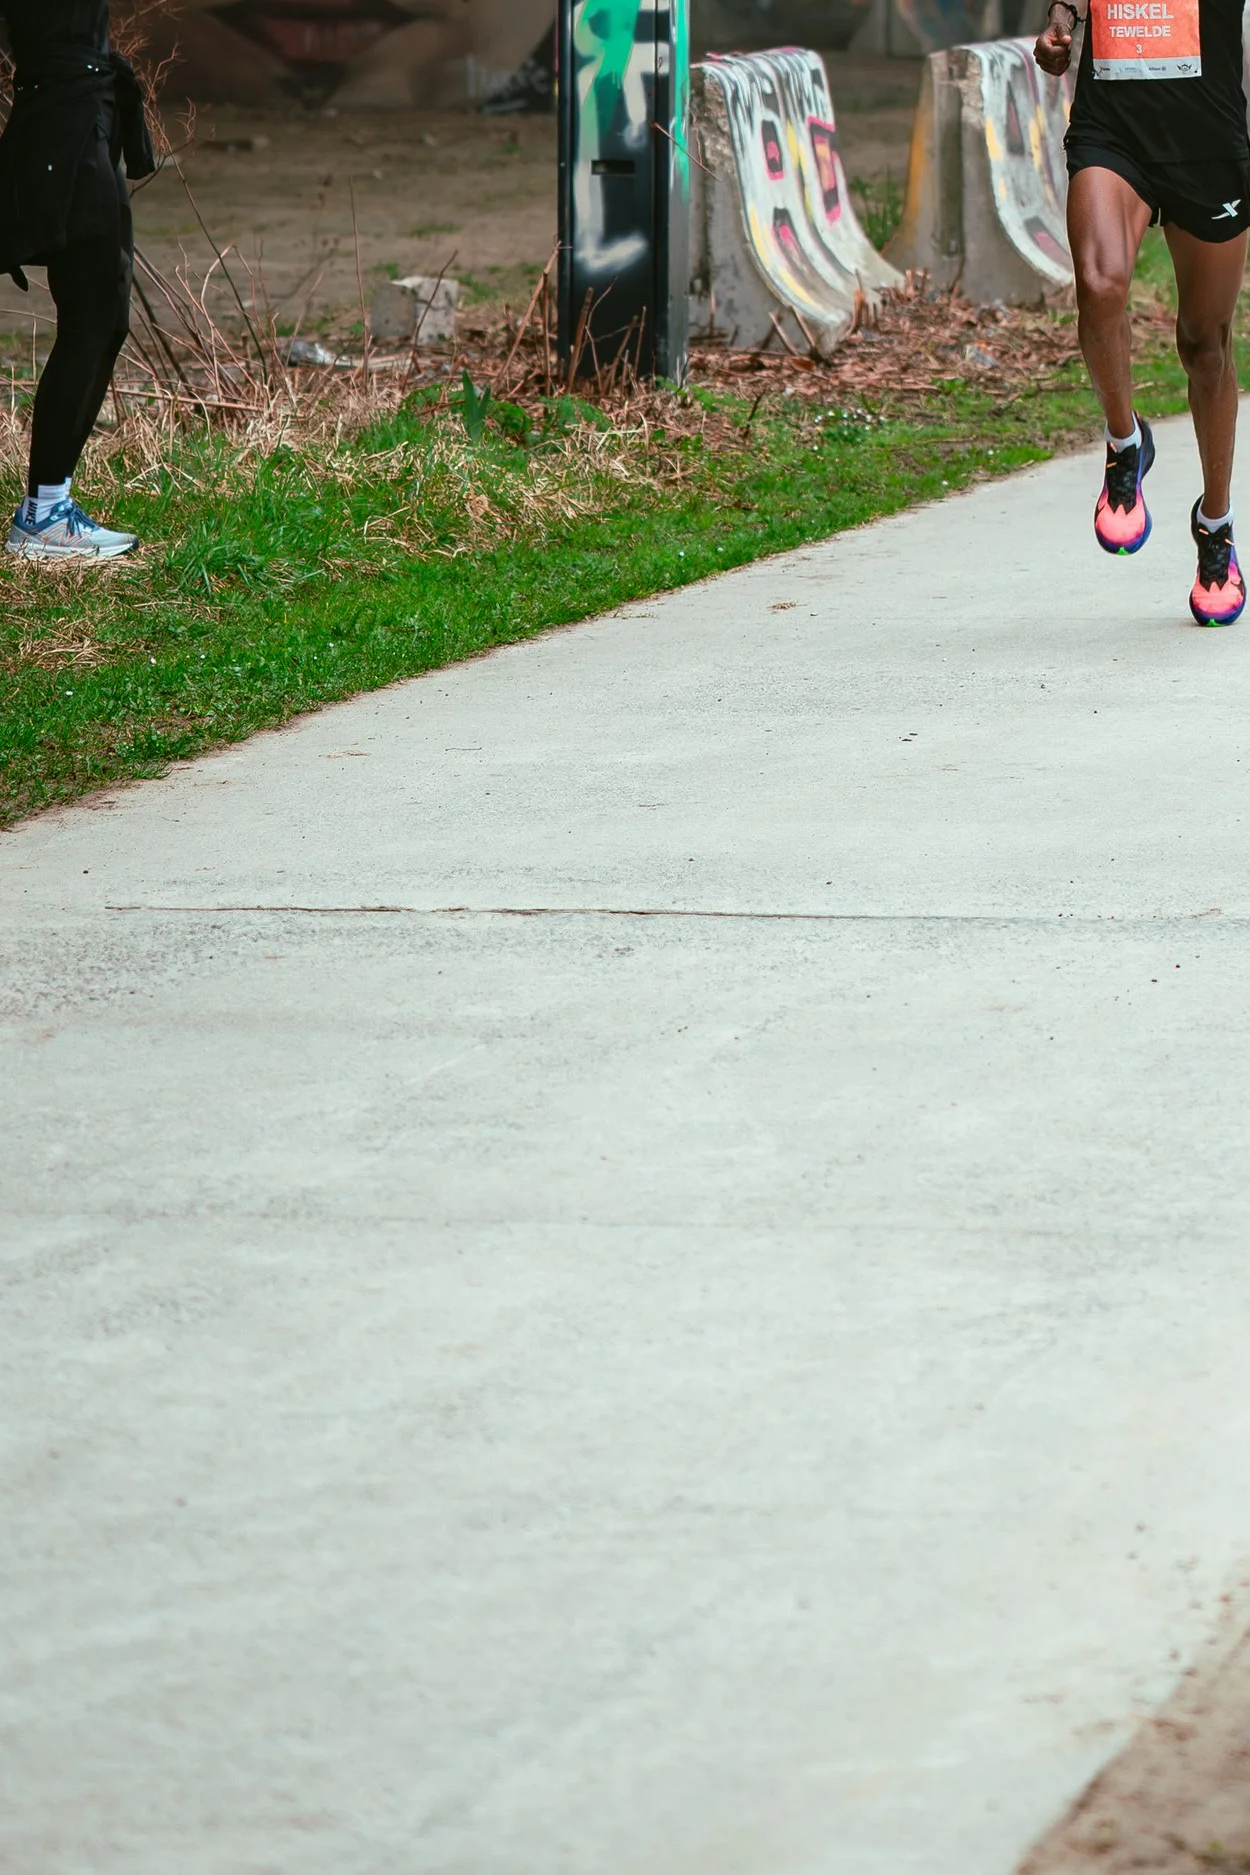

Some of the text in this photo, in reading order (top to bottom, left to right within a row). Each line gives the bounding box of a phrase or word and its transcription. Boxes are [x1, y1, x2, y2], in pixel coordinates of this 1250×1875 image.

[1107, 3, 1174, 20] HISKEL
[1109, 25, 1171, 38] TEWELDE
[1136, 44, 1143, 54] 3
[24, 500, 38, 526] NIKE
